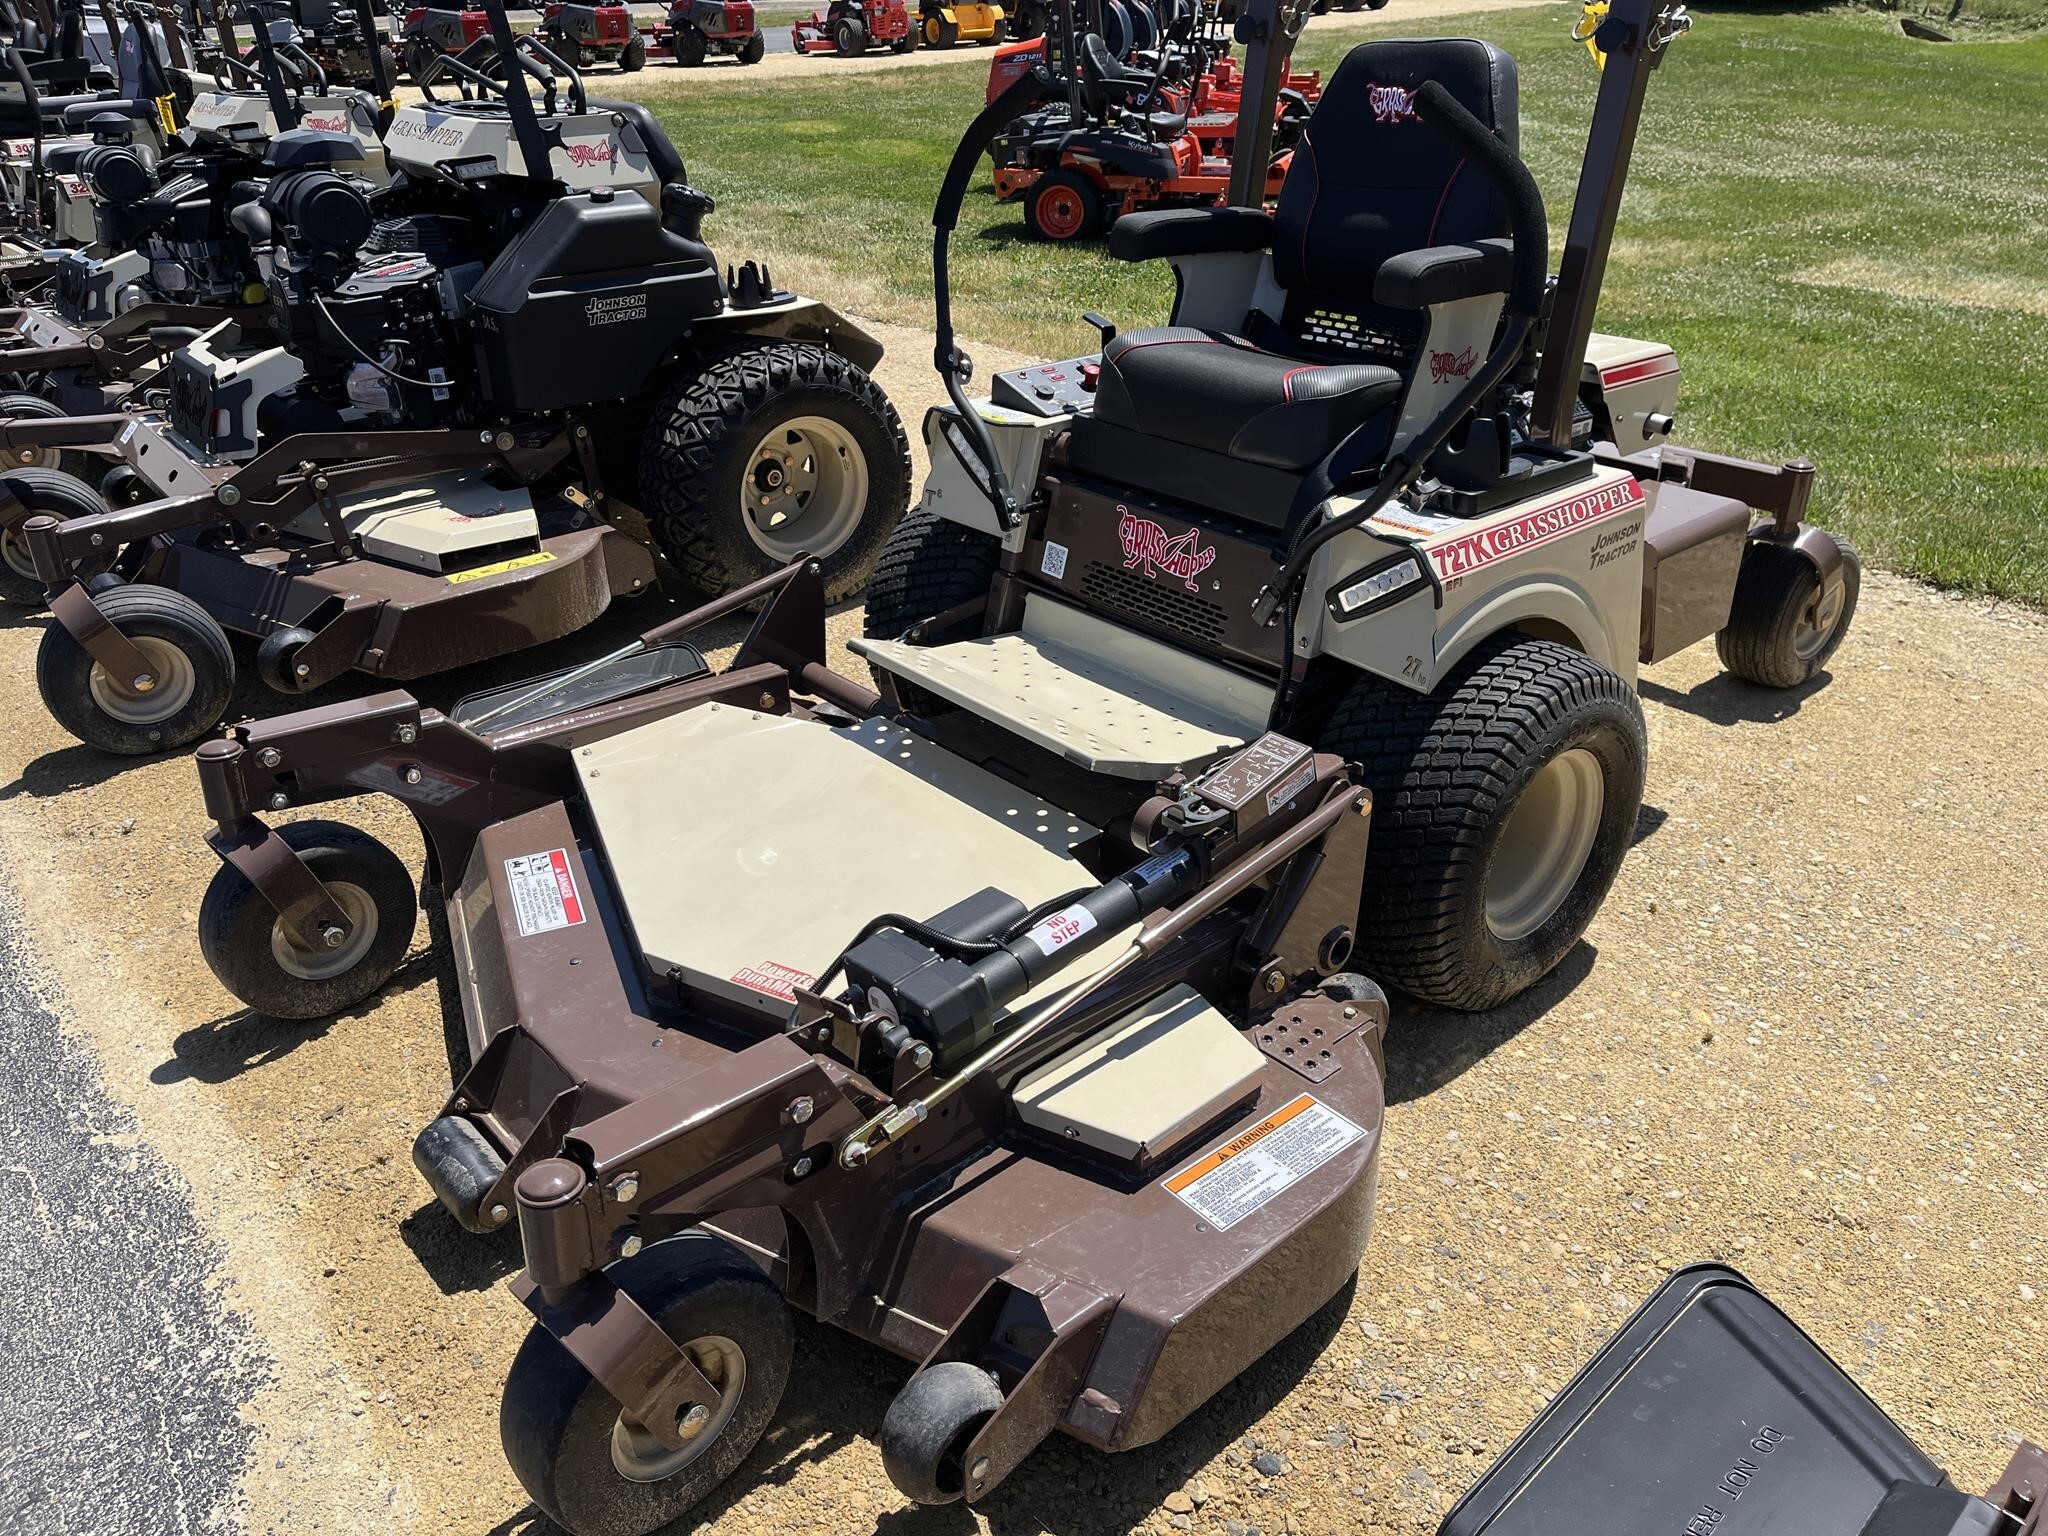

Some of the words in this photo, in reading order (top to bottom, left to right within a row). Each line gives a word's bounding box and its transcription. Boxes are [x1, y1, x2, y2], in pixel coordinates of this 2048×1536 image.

[585, 294, 646, 313] JOHNSON
[587, 308, 647, 326] TRACTOR
[1432, 533, 1495, 577] 727K
[1494, 482, 1634, 552] GRASSHOPPER
[1591, 521, 1642, 554] JOHNSON
[1117, 505, 1216, 592] GRASSHOPPER
[1589, 540, 1638, 571] TRACTOR
[1445, 576, 1463, 592] EFI
[557, 873, 573, 899] DANGER
[1047, 915, 1068, 929] NO
[1051, 919, 1081, 944] STEP
[736, 968, 797, 996] DURAMA
[1229, 1121, 1276, 1153] WARNING
[1751, 1425, 1785, 1454] DO
[1718, 1457, 1760, 1501] NOT
